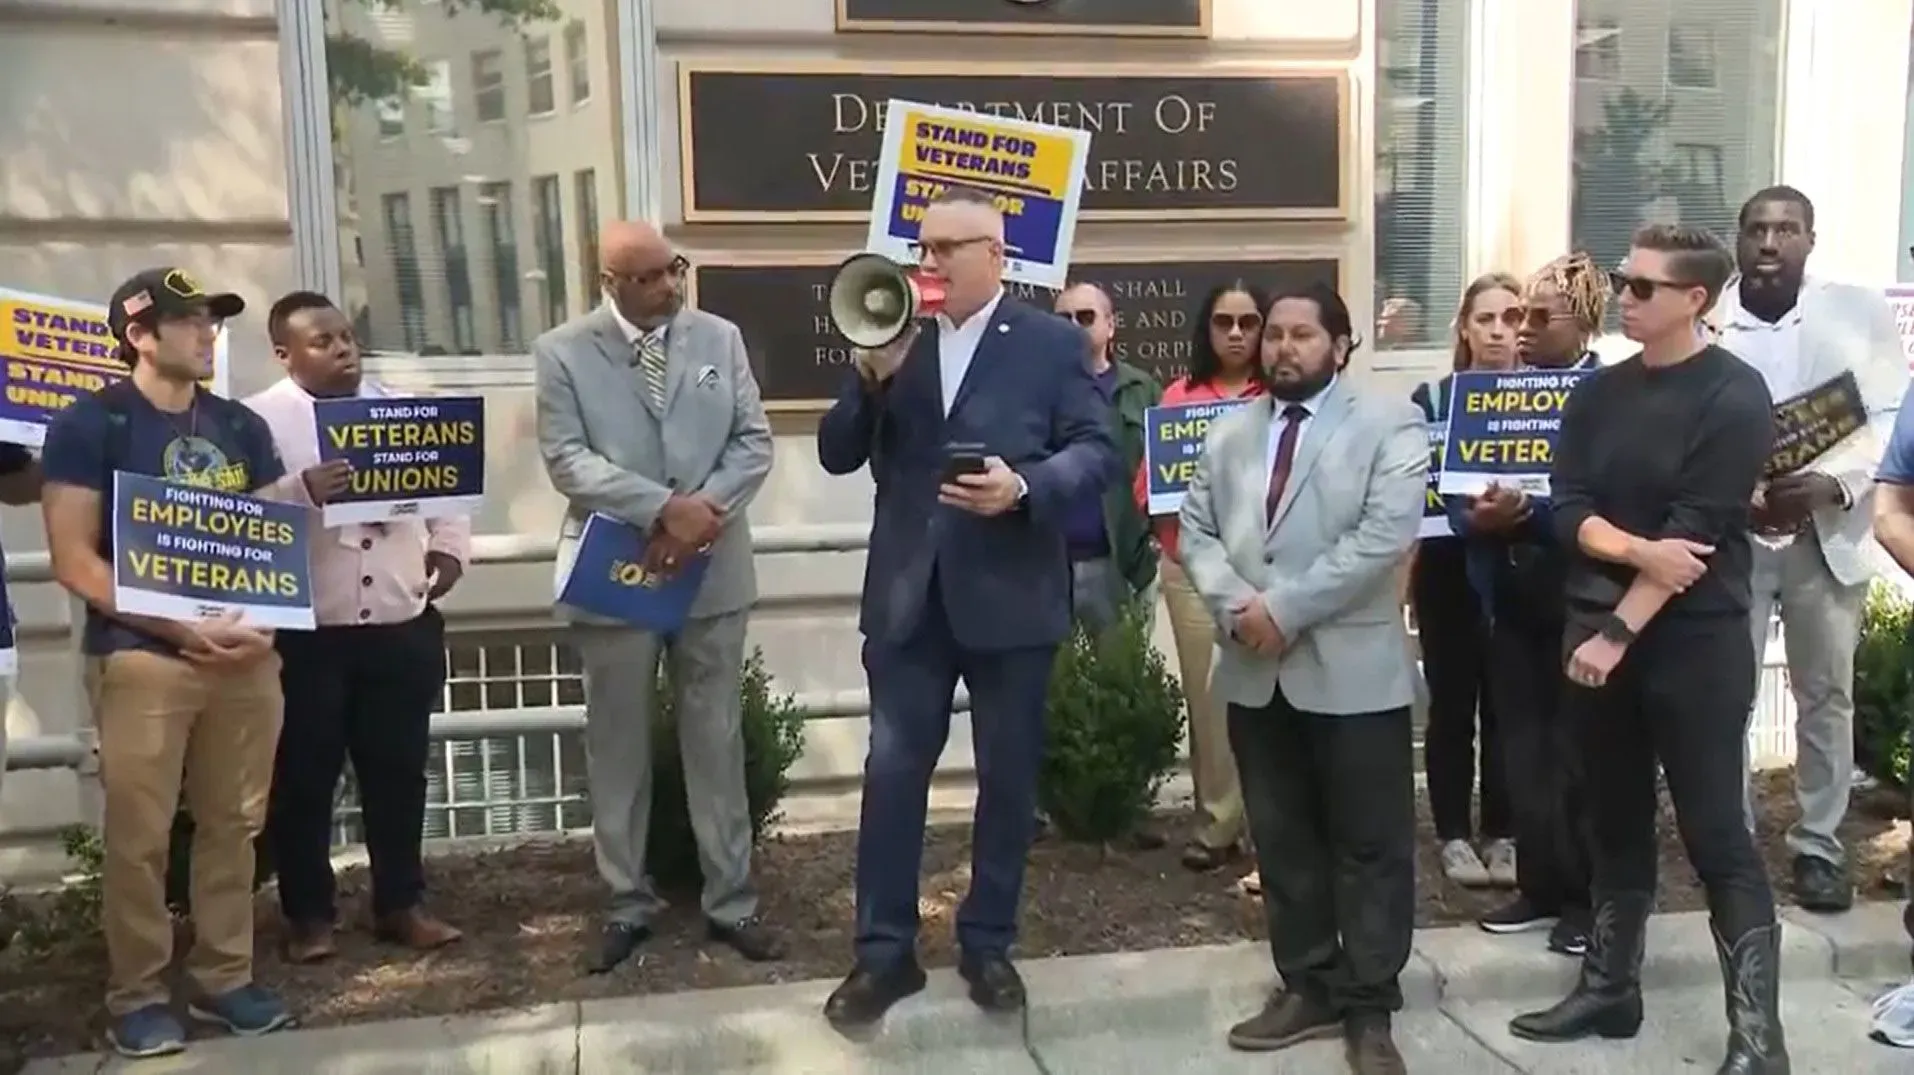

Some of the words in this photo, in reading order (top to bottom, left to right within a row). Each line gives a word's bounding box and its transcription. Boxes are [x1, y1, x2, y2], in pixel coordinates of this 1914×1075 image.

[832, 94, 1132, 133] DETMENT
[916, 122, 989, 148] STAND
[992, 134, 1037, 158] FOR
[916, 145, 1031, 179] VETERANS
[905, 180, 950, 200] STA
[1113, 279, 1187, 299] SHALL
[13, 307, 108, 336] STAND
[1136, 310, 1187, 328] AND
[8, 362, 105, 392] STAND
[370, 407, 412, 419] STAND
[415, 406, 438, 418] FOR
[328, 421, 474, 449] VETERANS
[373, 452, 413, 464] STAND
[416, 451, 439, 462] FOR
[1459, 439, 1553, 463] VETER
[352, 465, 458, 493] UNIONS
[166, 487, 237, 511] FIGHTING
[237, 501, 263, 517] FOR
[132, 497, 294, 545] EMPLOYEES
[157, 532, 171, 547] IS
[174, 536, 242, 558] FIGHTING
[244, 549, 272, 562] FOR
[128, 551, 299, 598] VETERANS
